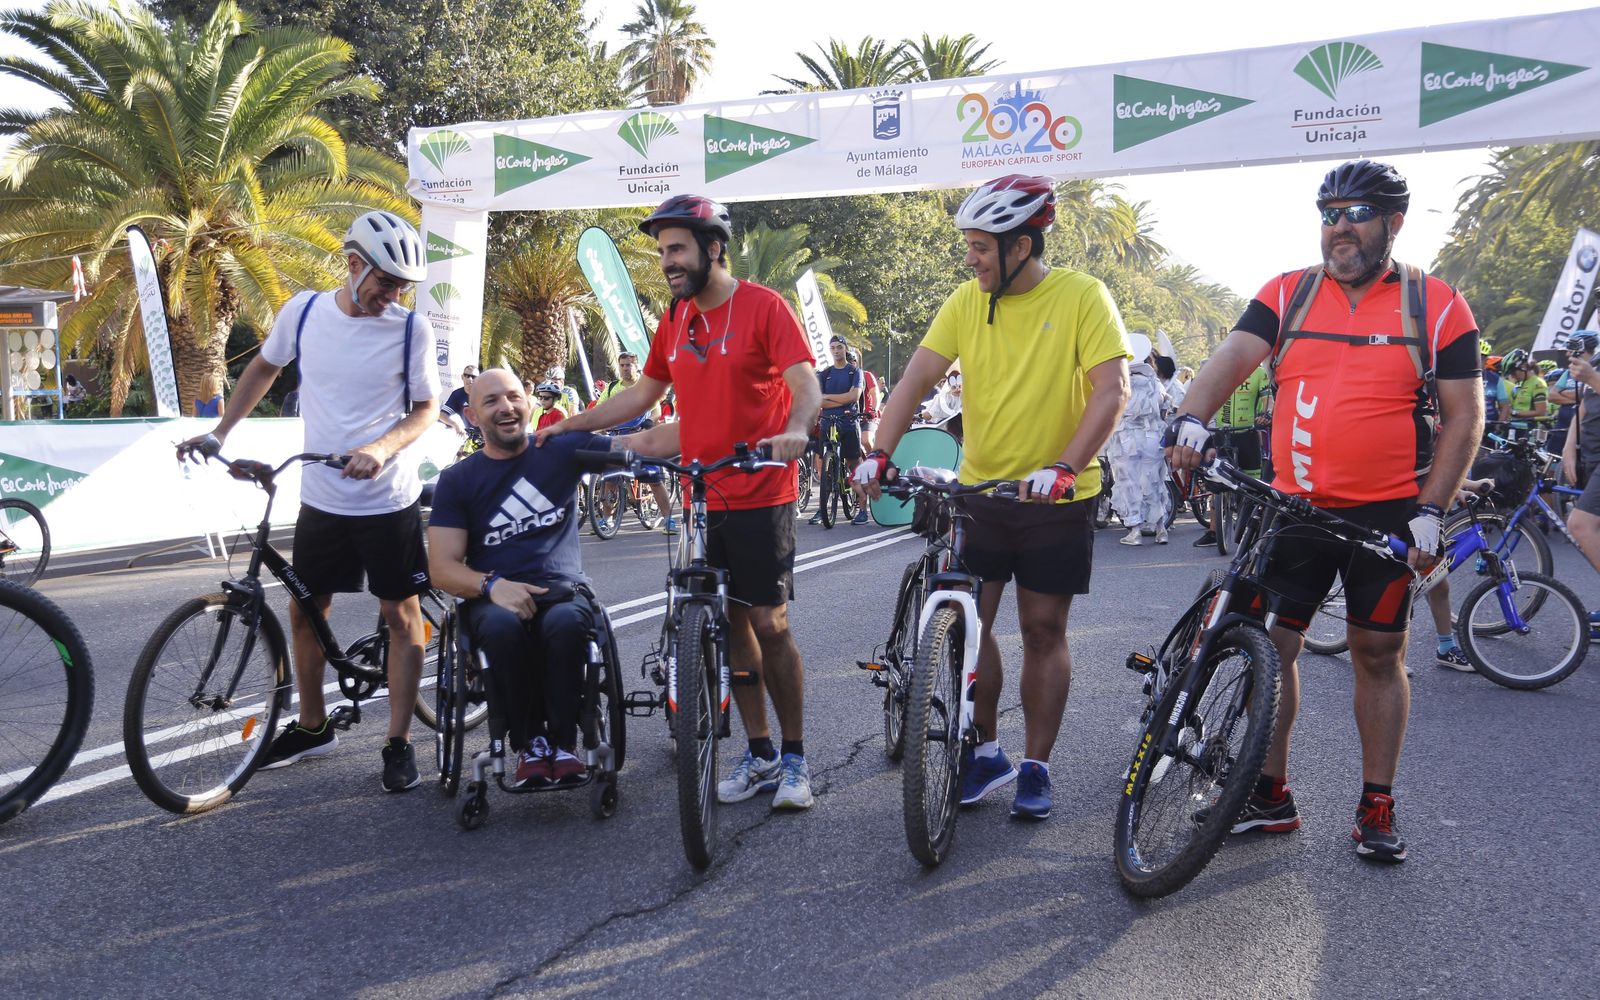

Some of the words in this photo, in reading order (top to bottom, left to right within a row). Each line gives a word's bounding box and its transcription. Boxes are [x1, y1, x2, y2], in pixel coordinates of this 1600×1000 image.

[1423, 72, 1442, 90] El
[1442, 70, 1484, 88] Corte
[1485, 63, 1549, 92] Inglés
[1116, 102, 1131, 120] El
[1131, 101, 1168, 118] Corte
[1167, 94, 1222, 122] Inglés
[1293, 104, 1381, 122] Fundación
[956, 92, 1083, 154] 2020
[1305, 125, 1367, 143] Unicaja
[706, 141, 718, 155] El
[718, 140, 748, 154] Corte
[747, 133, 791, 156] Inglés
[961, 141, 1023, 159] MÁLAGA
[496, 157, 506, 170] El
[506, 156, 531, 170] Corte
[530, 151, 569, 172] Inglés
[846, 147, 929, 164] Ayuntamiento
[961, 159, 1005, 169] EUROPEAN
[1007, 156, 1041, 166] CAPITAL
[1042, 154, 1055, 163] OF
[1056, 152, 1083, 162] SPORT
[619, 162, 679, 177] Fundación
[856, 166, 871, 179] de
[874, 163, 918, 178] Málaga
[627, 180, 670, 195] Unicaja
[1291, 380, 1318, 492] MTC
[1, 477, 16, 493] El
[15, 478, 47, 492] Corte
[483, 507, 566, 546] adidas
[281, 565, 312, 599] Fairway
[1125, 733, 1152, 796] MAXXIS
